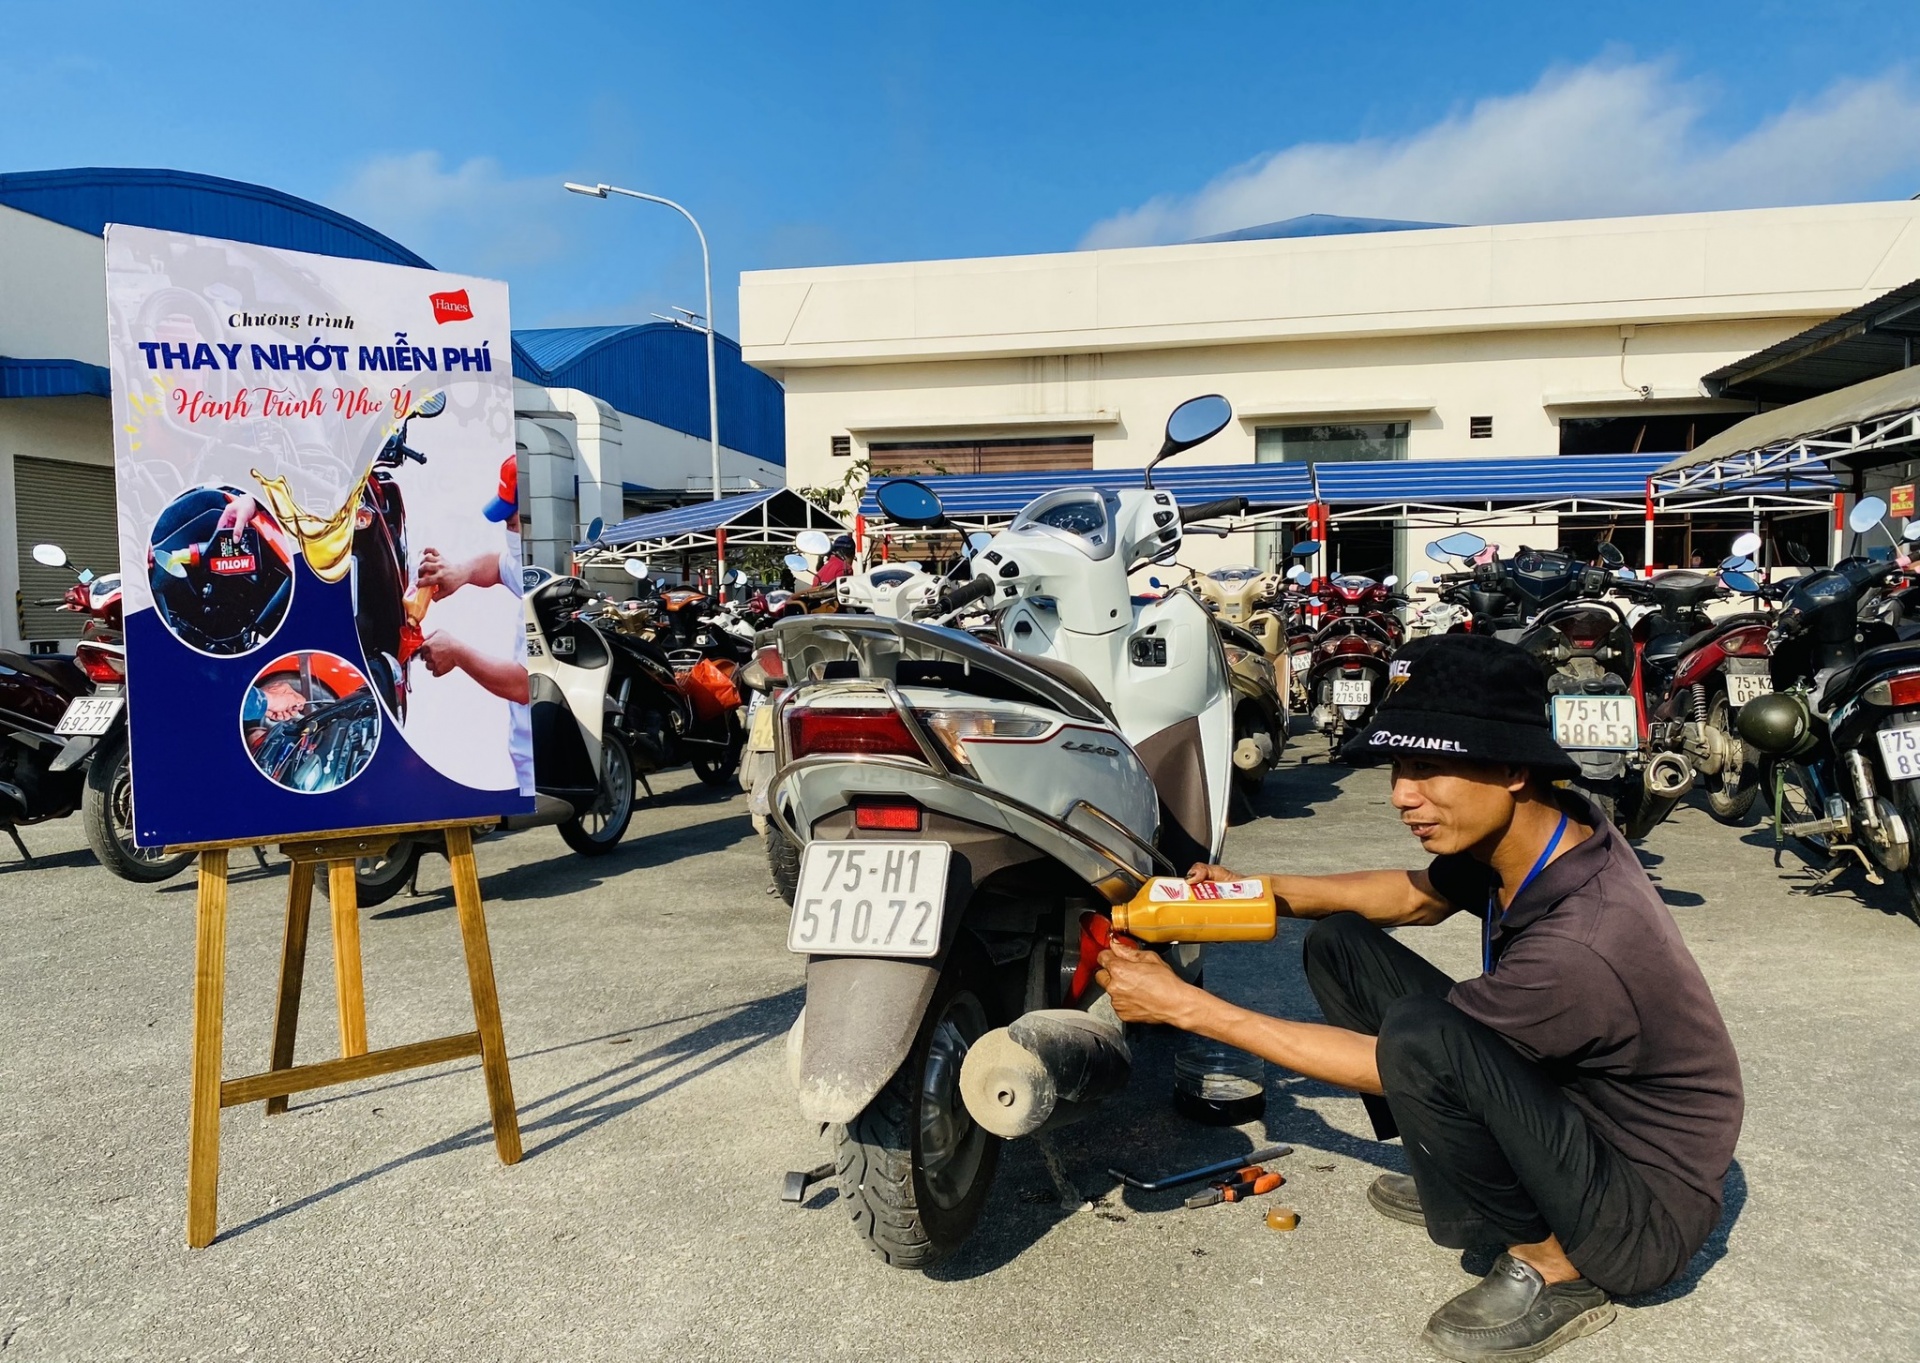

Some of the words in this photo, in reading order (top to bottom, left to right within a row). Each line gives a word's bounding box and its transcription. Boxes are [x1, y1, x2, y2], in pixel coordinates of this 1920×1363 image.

[435, 298, 469, 314] Hanes
[228, 312, 301, 329] Chương
[307, 314, 355, 330] trình
[138, 342, 242, 371] THAY
[251, 337, 350, 372] NHỚT
[358, 332, 435, 372] MIỄN
[443, 340, 492, 372] PHÍ
[172, 388, 252, 423] Hành
[251, 386, 328, 420] Trình
[332, 387, 382, 420] Như
[391, 384, 413, 420] Ý
[216, 558, 250, 571] MOTUL
[1340, 682, 1365, 692] 75-G1
[1336, 693, 1369, 703] 275.68
[74, 700, 114, 715] 75-H1
[1565, 700, 1620, 722] 75-K1
[61, 717, 112, 731] 692.77
[1559, 723, 1632, 746] 386.53
[1060, 740, 1121, 757] LEAD
[1388, 735, 1469, 753] CHANEL
[821, 849, 922, 893] 75-H1
[799, 898, 933, 946] 510.72
